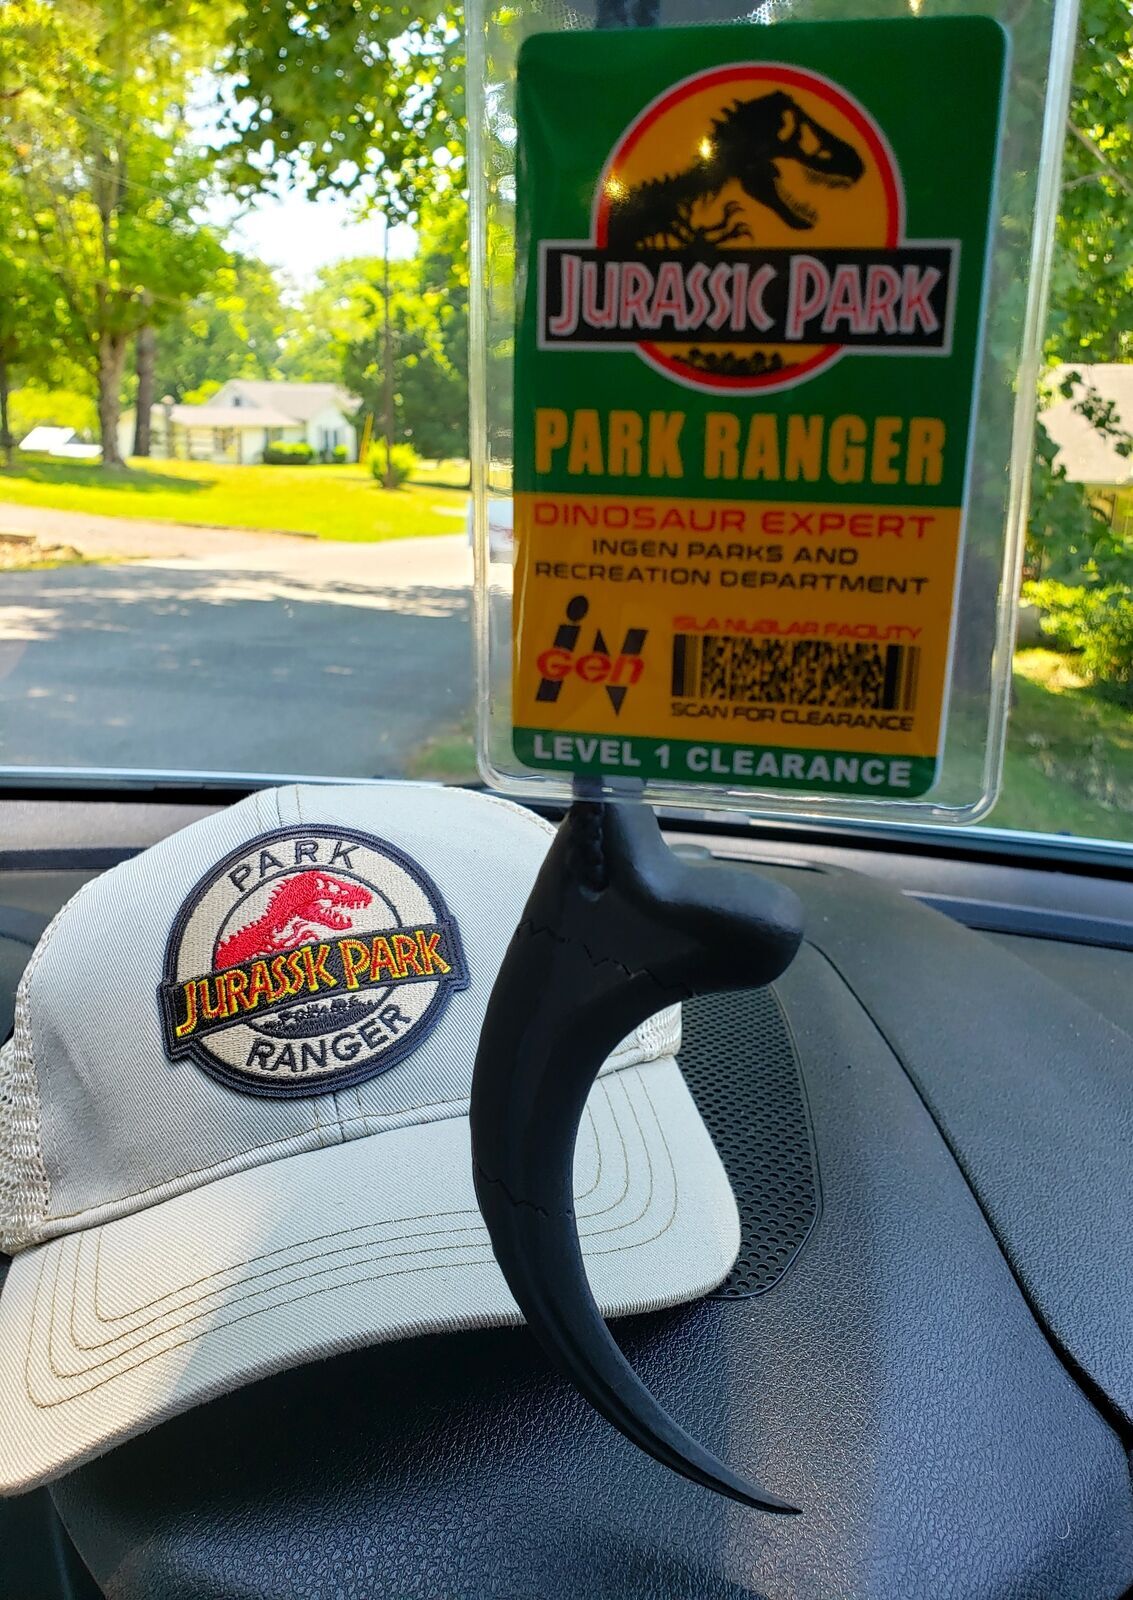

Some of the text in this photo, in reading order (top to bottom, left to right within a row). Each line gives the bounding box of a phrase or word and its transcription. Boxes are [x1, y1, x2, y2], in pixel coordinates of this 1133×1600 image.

[549, 254, 941, 339] JURASSIC PARK
[535, 408, 945, 485] PARK RANGER
[534, 503, 935, 539] DINOSAUR EXPERT
[592, 538, 858, 565] INGEN PARKS AND
[535, 562, 929, 595] RECREATION DEPARTMENT
[671, 702, 914, 732] SCAN FOR CLEARANCE
[533, 735, 912, 788] LEVEL 1 CLEARANCE
[228, 839, 360, 892] PARK
[339, 930, 451, 991] PARK
[247, 1003, 411, 1072] RANGER
